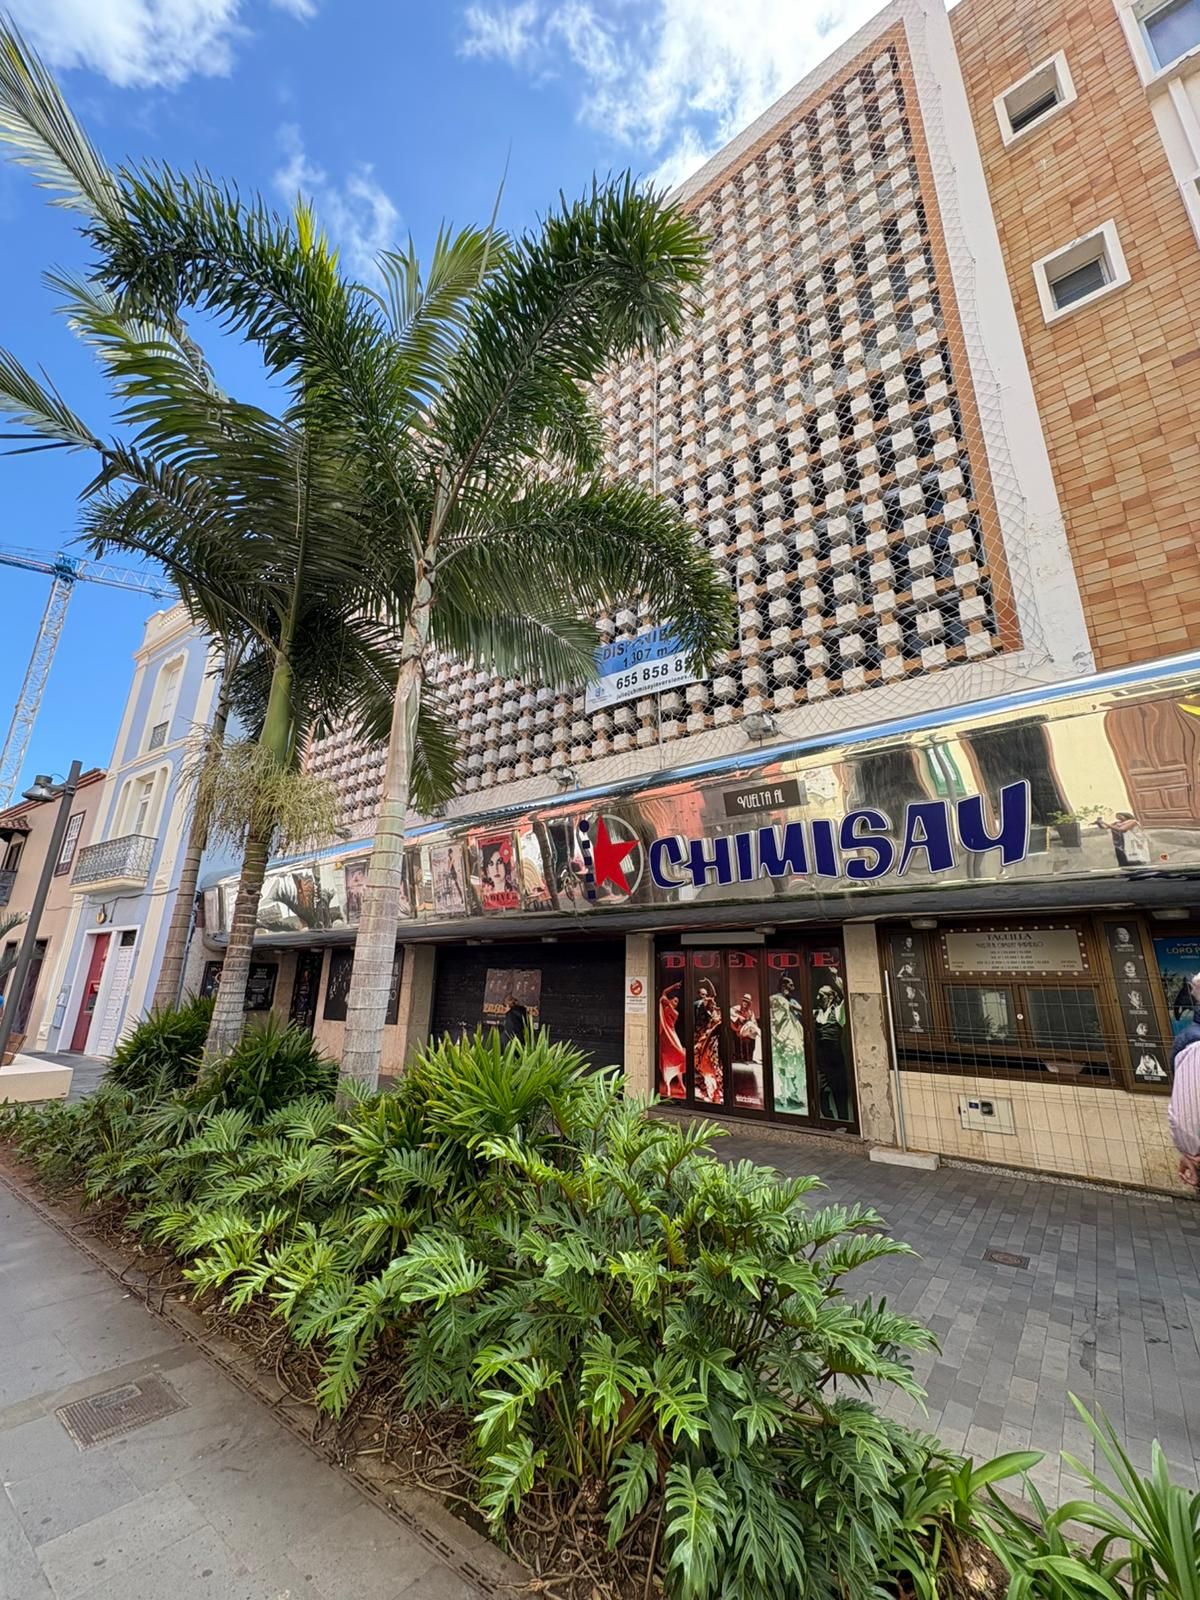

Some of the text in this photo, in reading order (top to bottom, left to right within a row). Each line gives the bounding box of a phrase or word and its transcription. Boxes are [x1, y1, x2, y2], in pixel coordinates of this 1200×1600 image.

[616, 671, 638, 690] 655
[642, 663, 669, 681] 858
[736, 788, 785, 809] VUELTA AL
[649, 778, 1031, 890] CHIMISAY
[986, 932, 1033, 941] TAQUILLA
